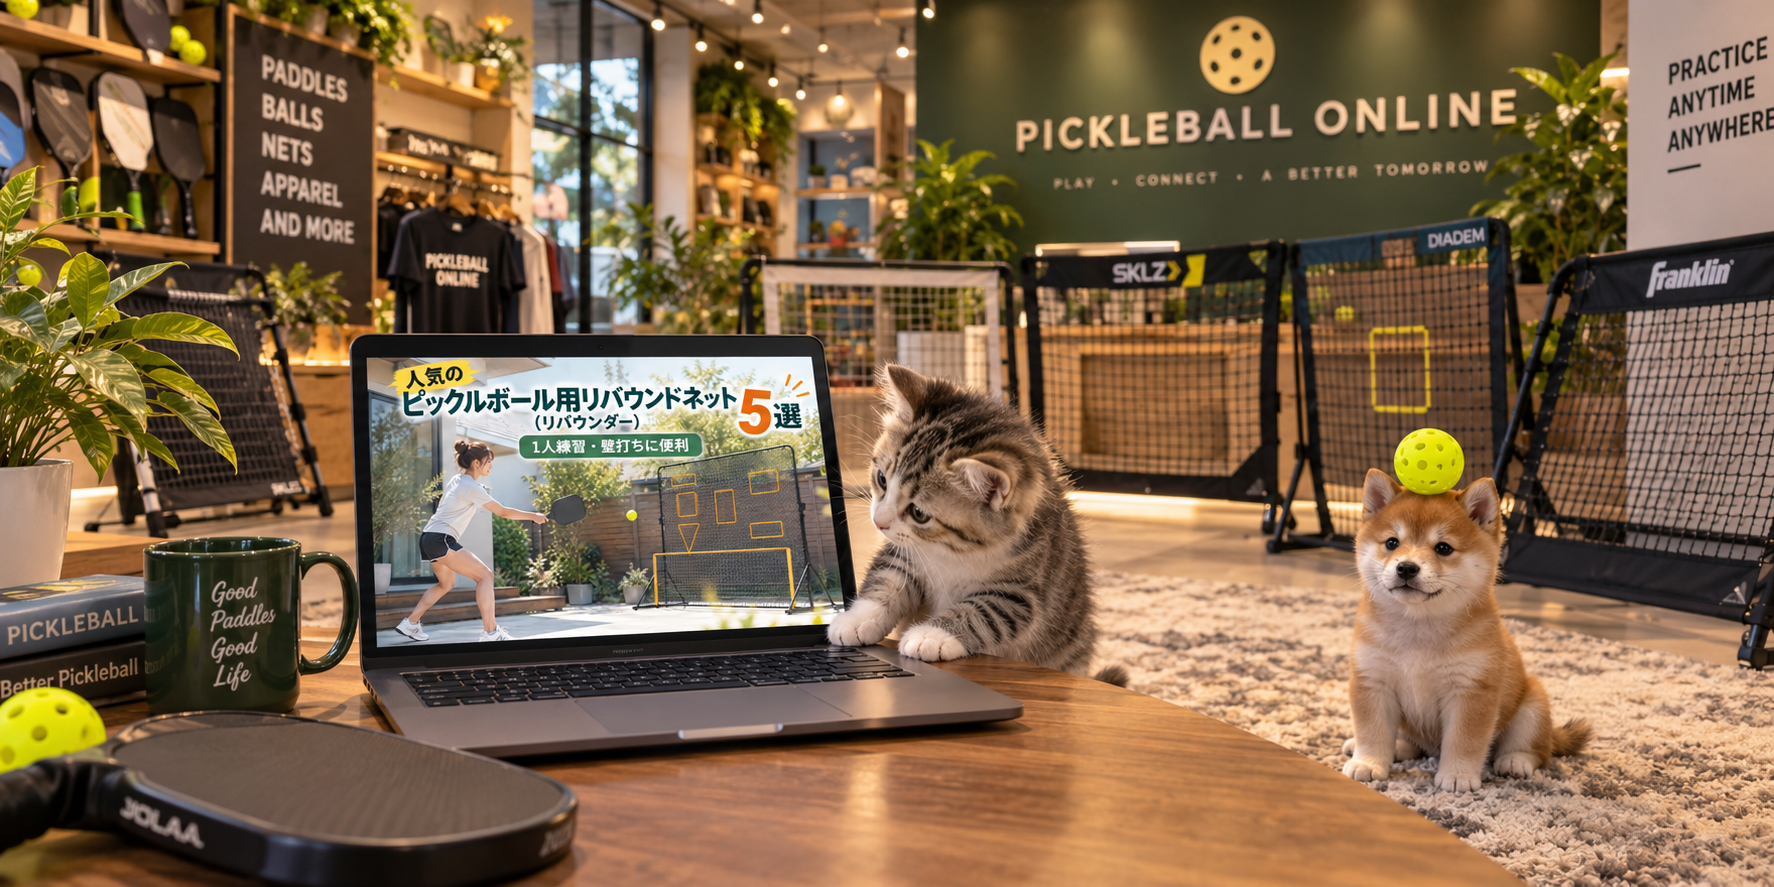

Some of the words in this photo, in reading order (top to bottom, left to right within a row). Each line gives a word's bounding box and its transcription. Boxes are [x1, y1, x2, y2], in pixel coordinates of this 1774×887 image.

[261, 53, 349, 103] PADDLES
[1668, 36, 1768, 85] PRACTICE
[261, 92, 324, 133] BALLS
[1667, 75, 1756, 119] ANYTIME
[1015, 103, 1293, 153] PICKLEBALL
[1313, 87, 1518, 136] ONLINE
[1667, 106, 1774, 153] ANYWHERE
[261, 130, 314, 167] NETS
[260, 170, 344, 209] APPAREL
[1053, 176, 1095, 190] PLAY
[1135, 170, 1218, 188] CONNECT
[1261, 168, 1273, 182] A
[1288, 165, 1358, 182] BETTER
[1374, 159, 1489, 177] TOMORROW
[260, 207, 302, 238] AND
[305, 214, 355, 245] MORE
[1427, 226, 1486, 249] DIADEM
[425, 252, 490, 274] PICKLEBALL
[435, 269, 480, 289] ONLINE
[1112, 260, 1168, 284] SKLZ
[406, 365, 464, 389] 人気の
[402, 386, 737, 417] ピックルボール用リバウンドネット
[738, 388, 803, 436] 5選
[211, 576, 259, 608] Good
[7, 605, 139, 646] PICKLEBALL
[210, 602, 277, 632] Paddles
[210, 631, 258, 664] Good
[0, 675, 55, 700] Better
[58, 656, 139, 689] Pickleball
[213, 661, 252, 692] Life
